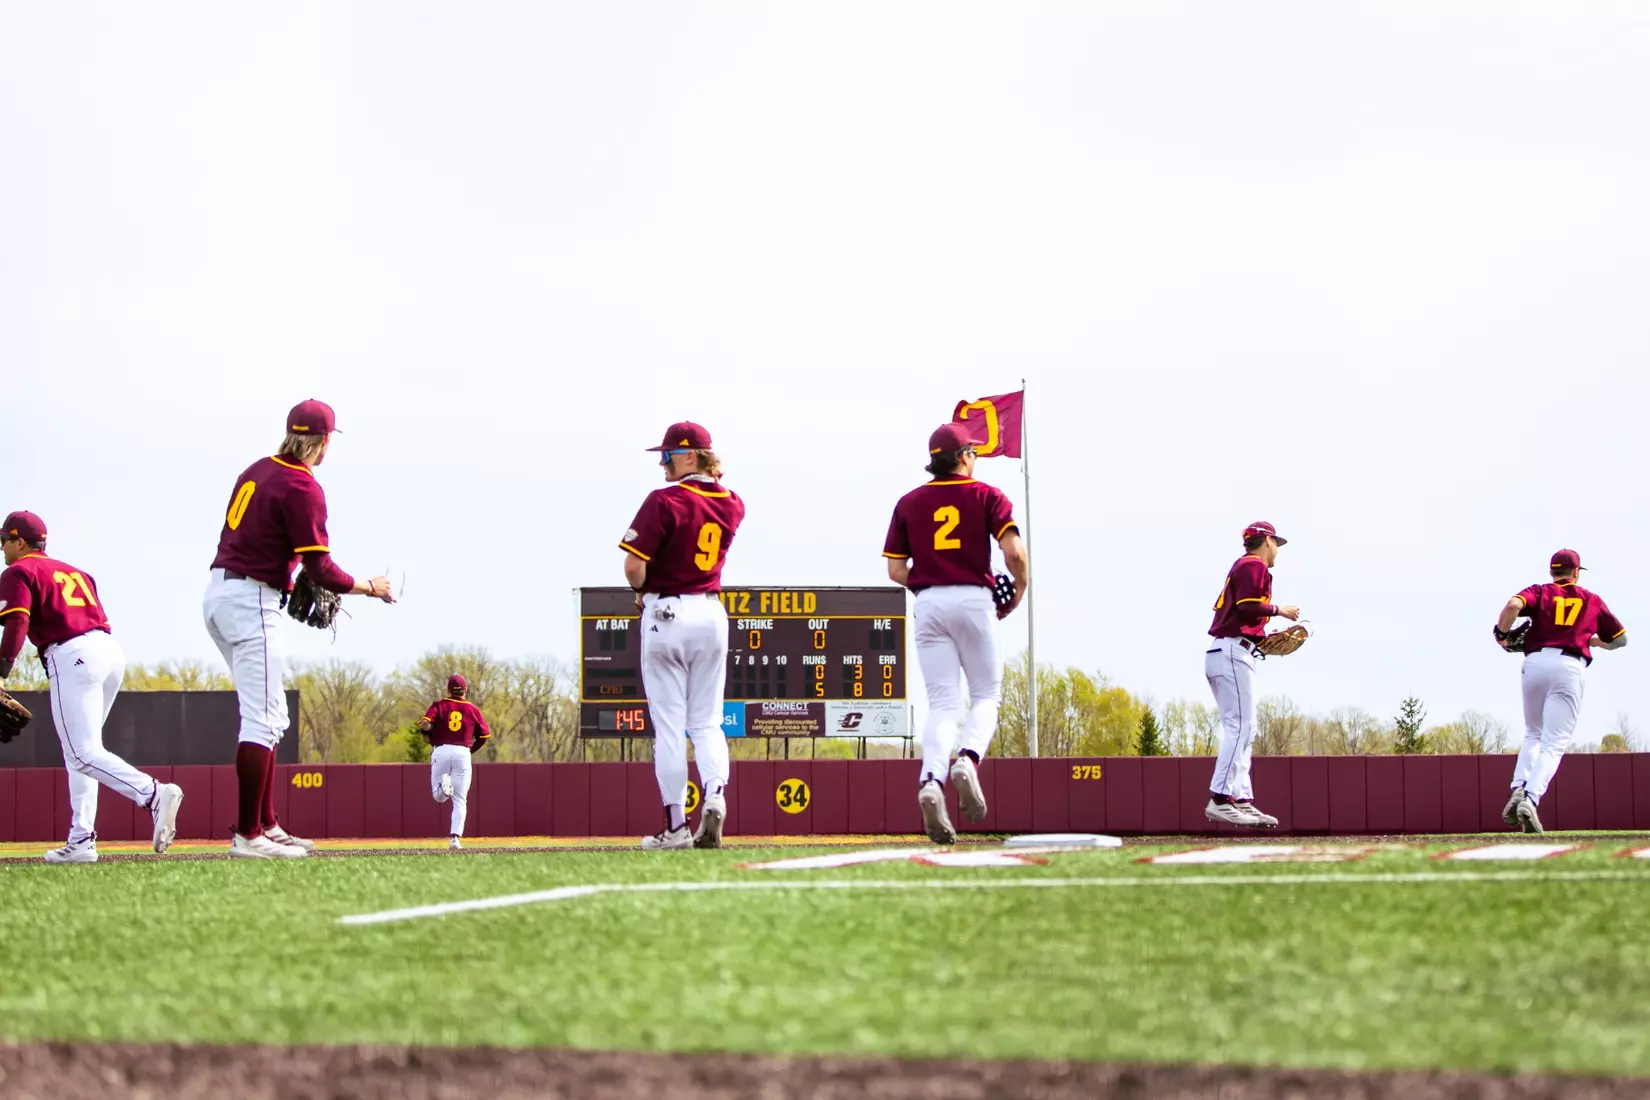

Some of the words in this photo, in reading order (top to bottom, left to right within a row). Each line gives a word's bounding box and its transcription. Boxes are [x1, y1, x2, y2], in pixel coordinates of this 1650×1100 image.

[226, 480, 257, 531] 0
[933, 505, 962, 551] 2
[694, 522, 723, 572] 9
[53, 570, 98, 607] 21
[760, 592, 817, 614] FIELD
[1553, 595, 1583, 626] 17
[596, 619, 610, 630] AT
[611, 619, 630, 630] BAT
[737, 619, 774, 630] STRIKE
[808, 619, 829, 630] OUT
[873, 619, 891, 630] H/E
[749, 630, 761, 649] 0
[814, 630, 826, 649] 0
[734, 655, 740, 665] 7
[748, 655, 755, 665] 8
[762, 655, 769, 665] 9
[776, 655, 787, 665] 10
[802, 655, 827, 665] RUNS
[843, 655, 863, 665] HITS
[879, 655, 896, 665] ERR
[854, 665, 863, 680] 3
[883, 665, 892, 680] 0
[815, 682, 825, 697] 5
[854, 682, 863, 697] 8
[883, 682, 892, 697] 0
[762, 702, 808, 710] CONNECT
[448, 710, 463, 732] 8
[616, 709, 645, 731] 1:45
[754, 718, 783, 726] Providing
[291, 772, 323, 788] 400
[1071, 765, 1102, 780] 375
[779, 785, 807, 808] 34
